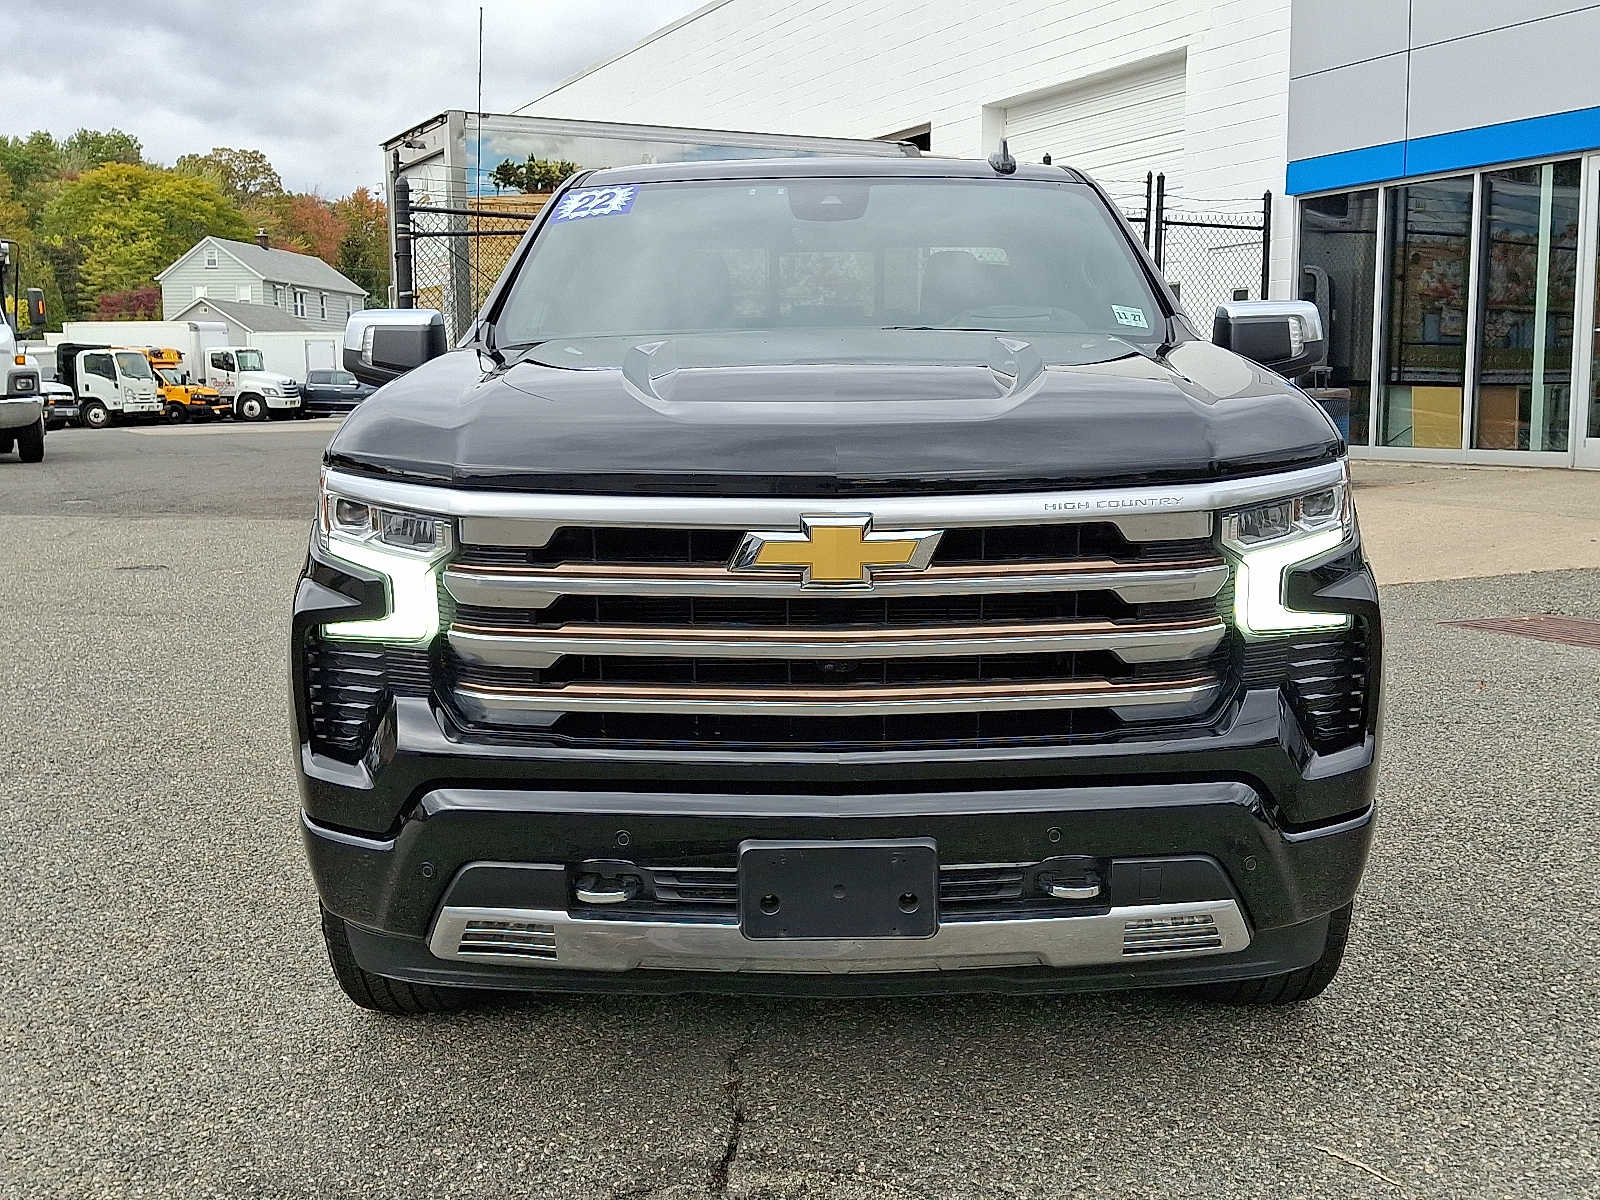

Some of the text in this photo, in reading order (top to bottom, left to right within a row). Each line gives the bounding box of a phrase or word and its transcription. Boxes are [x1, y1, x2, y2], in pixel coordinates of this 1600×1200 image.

[569, 191, 617, 214] 22
[1044, 496, 1184, 511] HIGH COUNTRY
